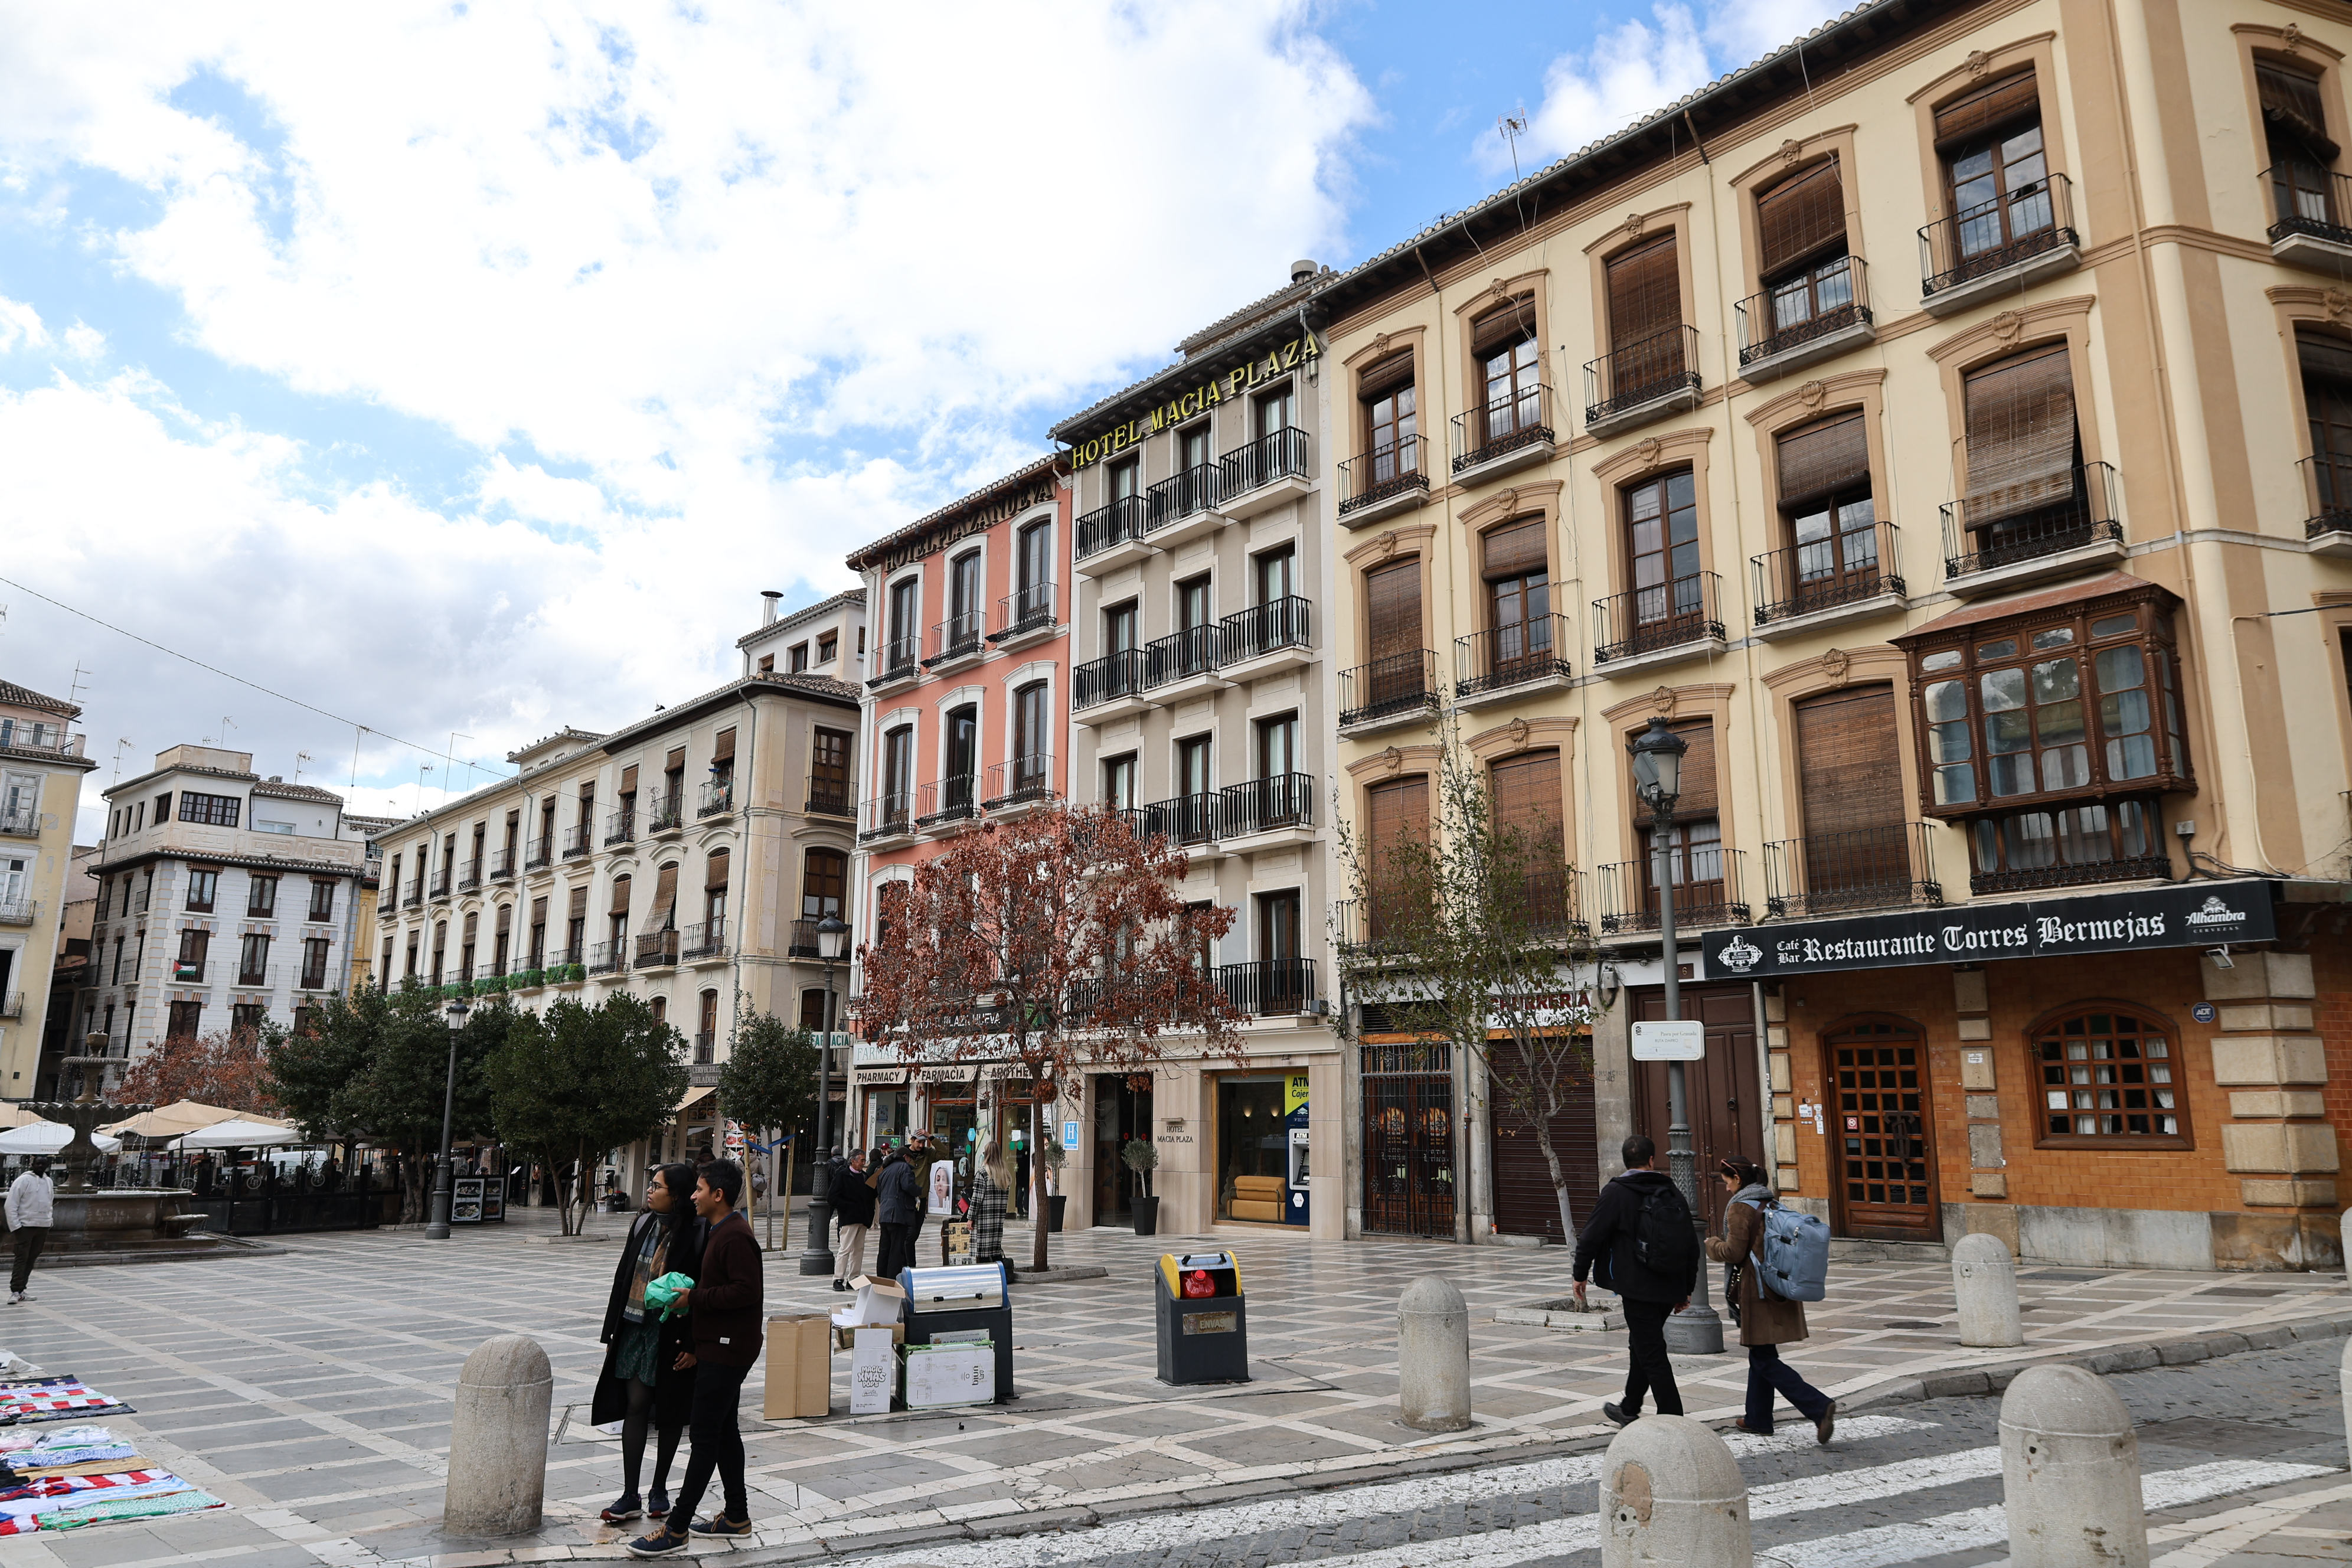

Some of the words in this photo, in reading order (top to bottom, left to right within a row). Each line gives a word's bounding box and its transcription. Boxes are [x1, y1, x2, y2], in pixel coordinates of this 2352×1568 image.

[1072, 419, 1144, 470] HOTEL
[1150, 380, 1221, 434] MACIA
[1229, 333, 1319, 396] PLAZA
[886, 537, 937, 573] HOTEL
[939, 509, 993, 547] PLAZA
[992, 479, 1054, 522] NUEVA
[2184, 910, 2246, 926] Alhambra
[1802, 931, 1937, 963] Restaurante
[1942, 923, 2028, 952] Torres
[2036, 912, 2167, 948] Bermejas
[1777, 939, 1799, 951] Café
[1777, 952, 1800, 965] Bar
[1682, 966, 1688, 975] 6
[857, 1072, 900, 1083] PHARMACY
[861, 1365, 883, 1374] MAGIC
[857, 1372, 887, 1383] XMAS
